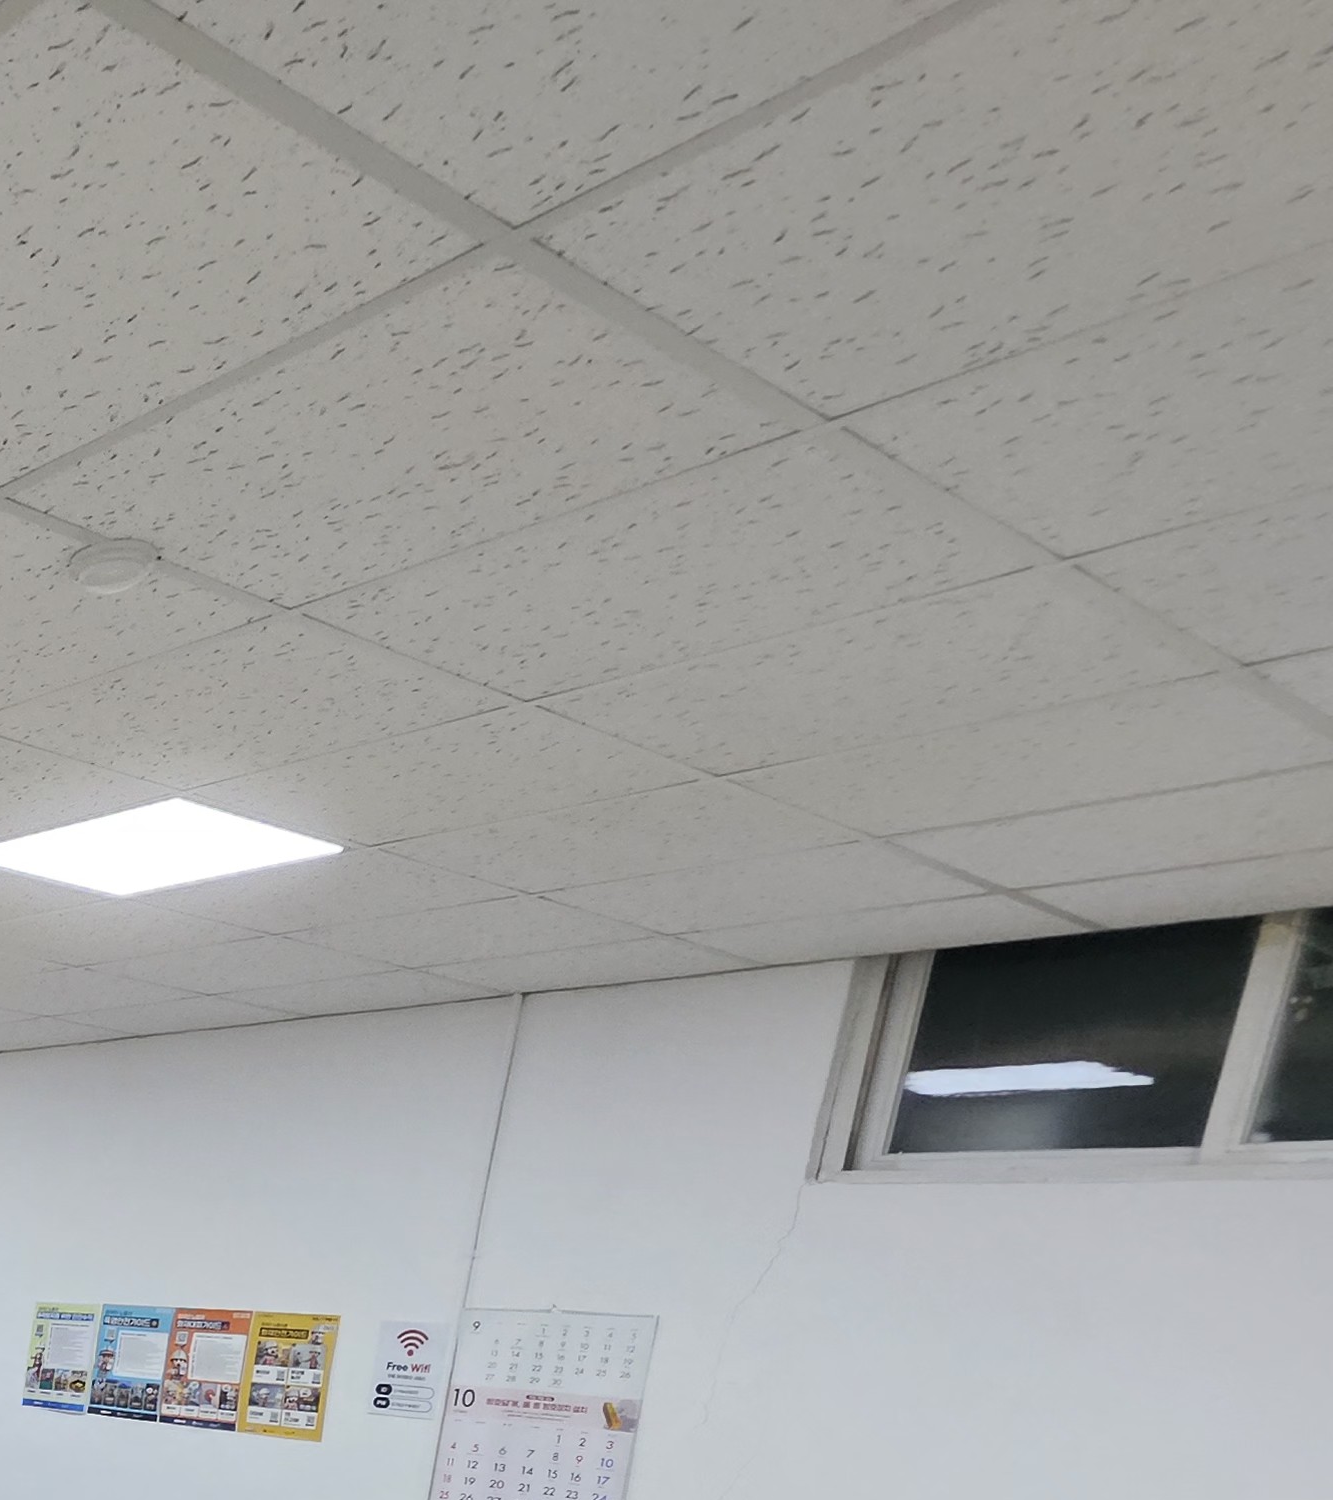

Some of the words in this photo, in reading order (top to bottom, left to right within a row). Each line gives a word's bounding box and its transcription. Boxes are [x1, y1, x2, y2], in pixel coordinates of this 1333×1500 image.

[472, 1321, 481, 1330] 9
[386, 1362, 408, 1371] Free
[411, 1364, 431, 1373] Wifi
[453, 1388, 476, 1408] 10
[557, 1434, 561, 1444] 1
[579, 1437, 586, 1447] 2
[605, 1440, 614, 1449] 3
[472, 1443, 480, 1453] 5
[498, 1447, 507, 1455] 6
[526, 1449, 535, 1458] 7
[552, 1452, 559, 1461] 8
[576, 1455, 583, 1464] 9
[600, 1457, 614, 1468] 10
[447, 1458, 455, 1466] 11
[467, 1460, 479, 1469] 12
[494, 1463, 506, 1472] 13
[521, 1466, 533, 1475] 14
[548, 1469, 558, 1479] 15
[570, 1472, 581, 1482] 16
[597, 1475, 611, 1485] 17
[439, 1490, 449, 1499] 25
[464, 1476, 476, 1485] 19
[489, 1479, 505, 1489] 20
[518, 1483, 530, 1493] 21
[543, 1486, 556, 1496] 22
[565, 1489, 579, 1500] 23
